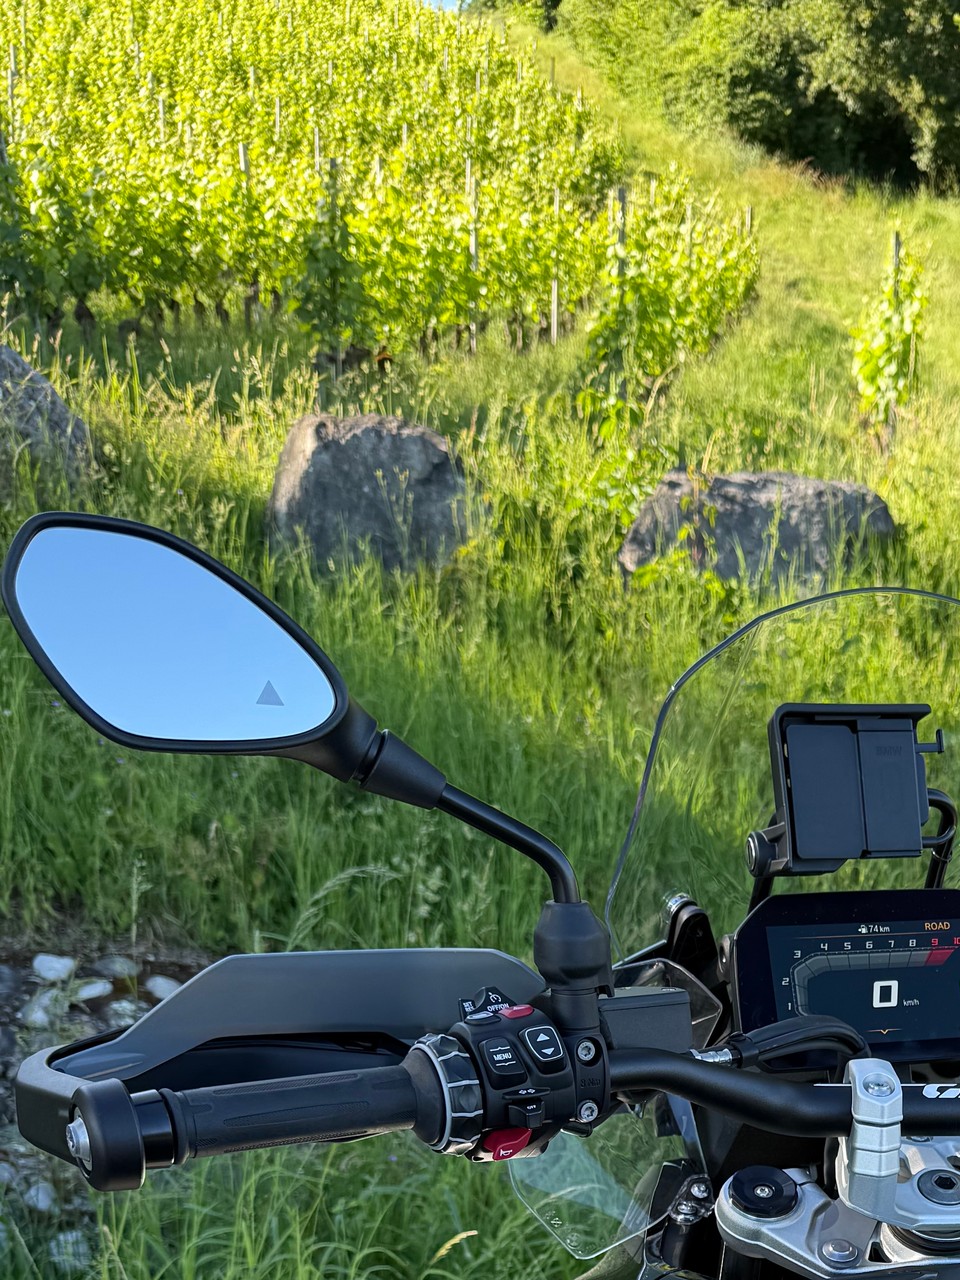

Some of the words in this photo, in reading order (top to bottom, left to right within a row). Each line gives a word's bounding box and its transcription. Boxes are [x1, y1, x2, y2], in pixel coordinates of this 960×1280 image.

[868, 925, 879, 933] 74
[879, 925, 890, 933] km
[924, 922, 951, 931] ROAD
[820, 943, 828, 951] 4
[844, 942, 851, 950] 5
[865, 941, 873, 949] 6
[888, 940, 895, 948] 7
[909, 939, 916, 947] 8
[931, 938, 939, 946] 9
[793, 950, 801, 959] 3
[781, 977, 790, 986] 2
[872, 980, 899, 1008] 0
[902, 999, 920, 1007] km/h
[787, 1002, 792, 1011] 1
[493, 1052, 513, 1062] MENU
